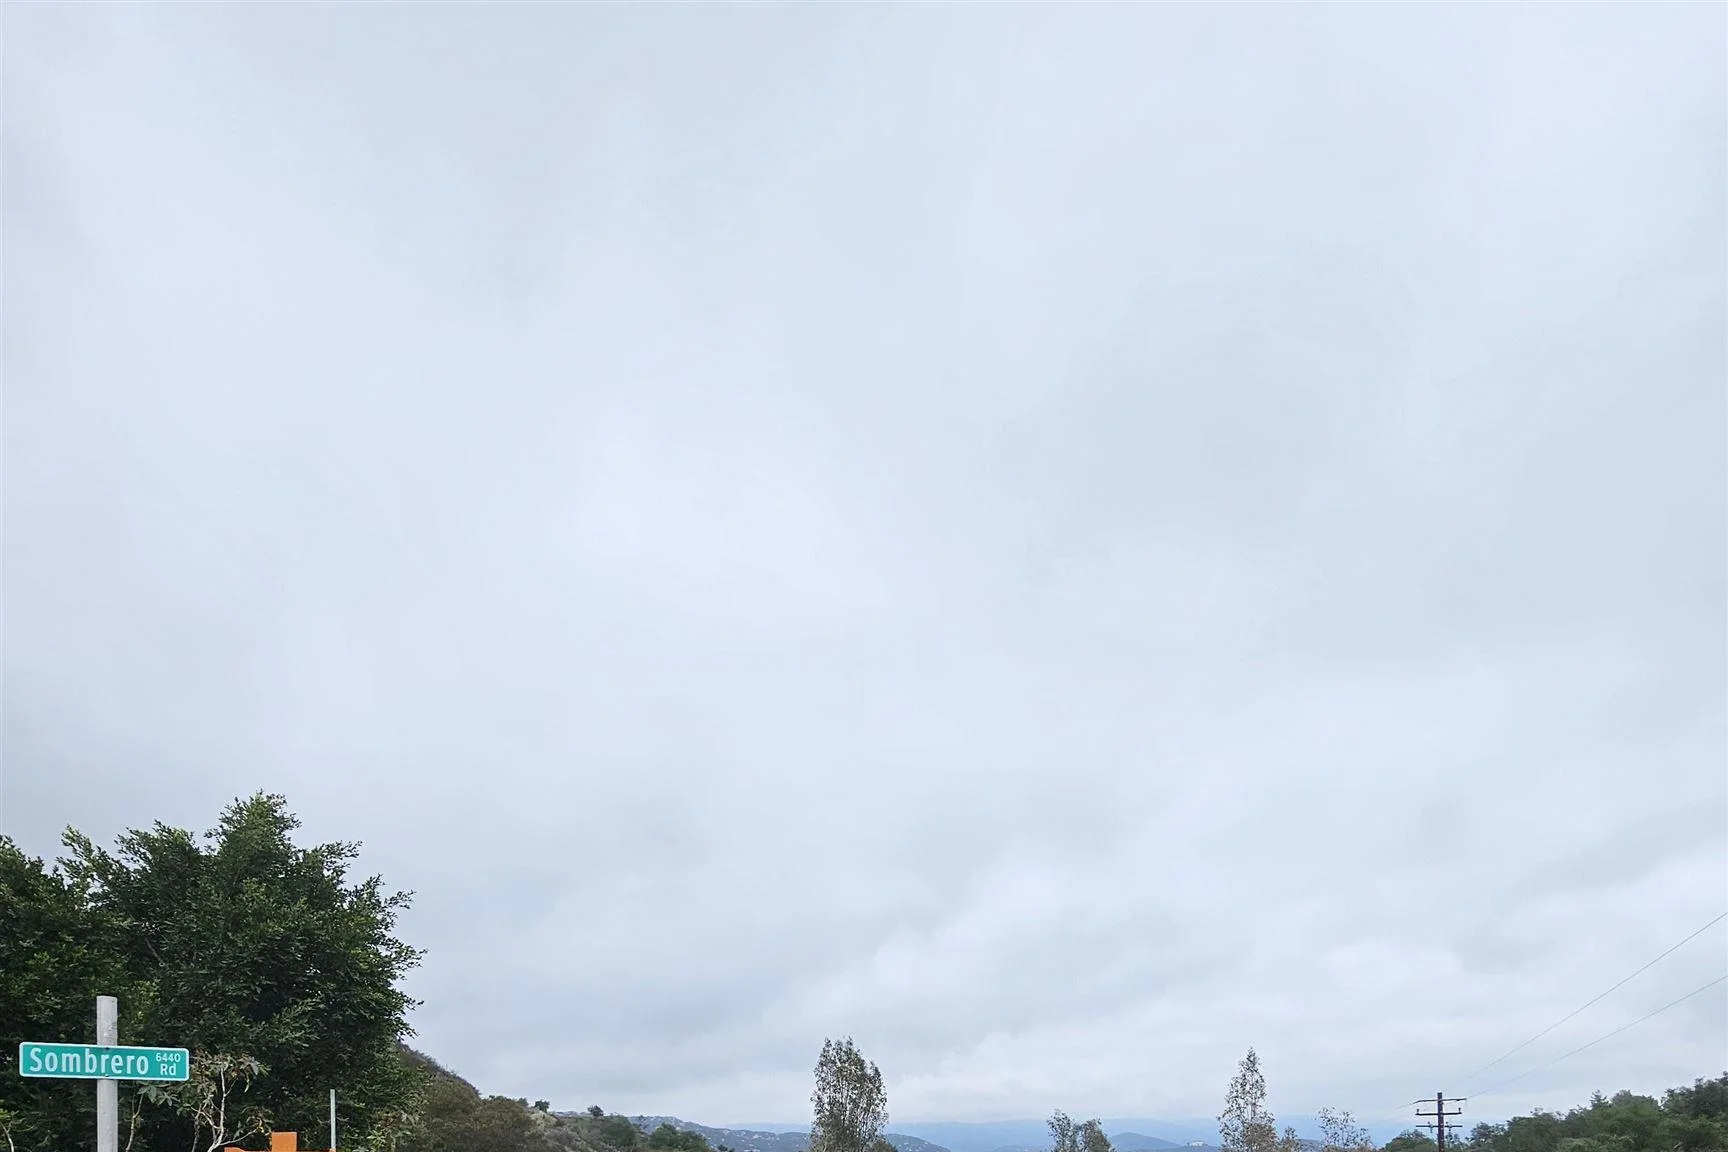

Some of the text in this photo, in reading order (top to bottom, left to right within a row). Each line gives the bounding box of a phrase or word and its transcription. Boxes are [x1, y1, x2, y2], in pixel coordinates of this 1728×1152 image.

[29, 1047, 149, 1075] Sombrero
[155, 1052, 181, 1063] 6440
[160, 1063, 177, 1076] Rd
